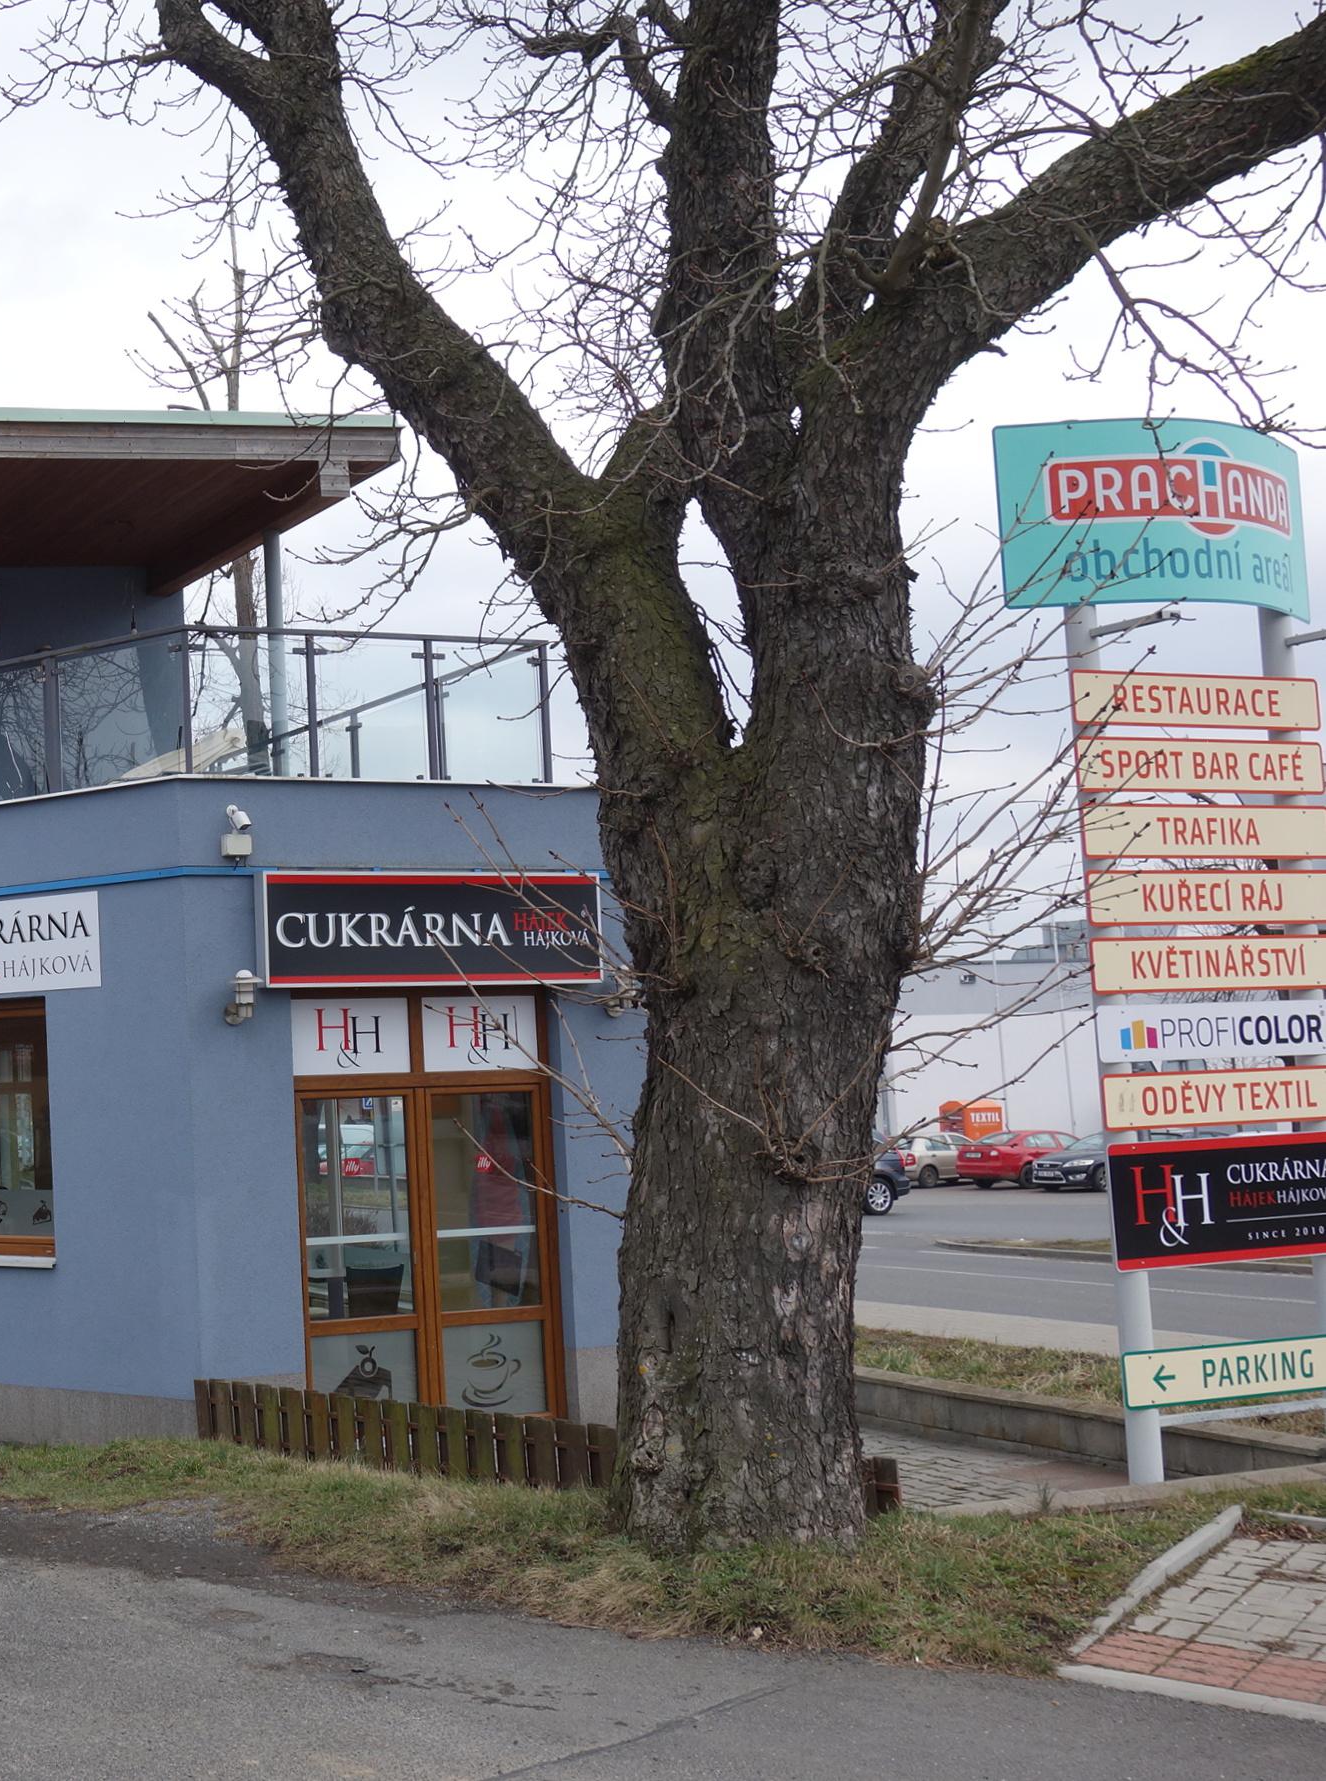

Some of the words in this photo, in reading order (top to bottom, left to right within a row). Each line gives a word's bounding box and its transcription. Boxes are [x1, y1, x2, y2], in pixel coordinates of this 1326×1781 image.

[1057, 459, 1289, 529] PRACHANDA
[1066, 537, 1241, 583] obchodní
[1252, 552, 1293, 594] areál
[1112, 684, 1282, 718] RESTAURACE
[1101, 749, 1183, 780] SPORT
[1192, 751, 1239, 780] BAR
[1248, 749, 1304, 781] CAFÉ
[1156, 816, 1261, 846] TRAFIKA
[1142, 878, 1232, 912] KUŘECÍ
[1241, 879, 1283, 912] RÁJ
[275, 905, 513, 949] CUKRÁRNA
[523, 928, 593, 950] HÁJKOVÁ
[1131, 944, 1306, 979] KVĚTINÁŘSTVÍ
[1160, 1014, 1324, 1049] PROFICOLOR
[1141, 1080, 1226, 1116] ODĚVY
[1232, 1080, 1318, 1111] TEXTIL
[970, 1112, 1001, 1123] TEXTIL
[345, 1160, 361, 1174] illy
[477, 1156, 492, 1170] illy
[1247, 1229, 1286, 1241] SINCE
[1295, 1225, 1325, 1237] 2010
[1202, 1349, 1315, 1389] PARKING
